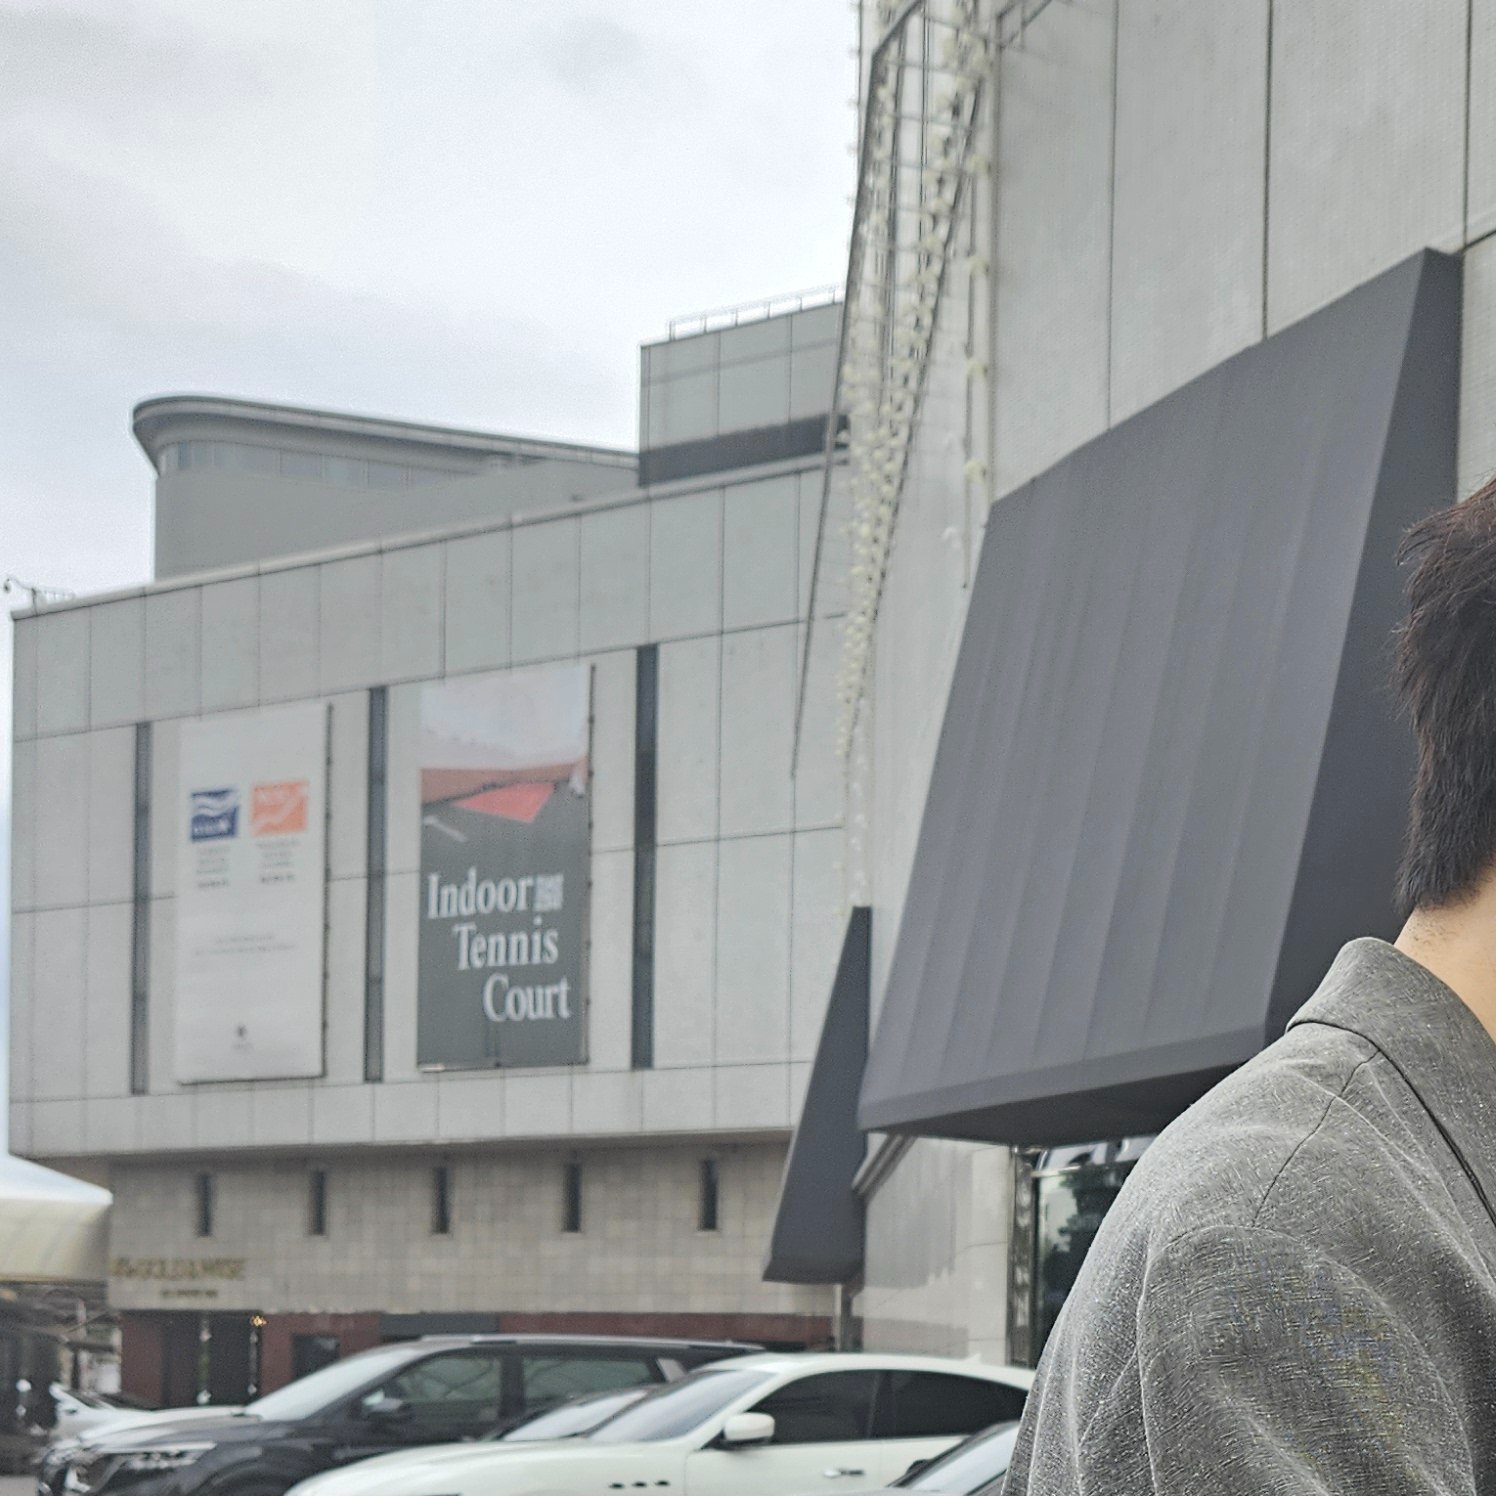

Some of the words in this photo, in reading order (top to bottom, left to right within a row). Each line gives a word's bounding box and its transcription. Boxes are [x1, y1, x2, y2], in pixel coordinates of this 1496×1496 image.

[427, 866, 534, 919] Indoor
[453, 914, 559, 970] Tennis
[483, 972, 571, 1022] Court
